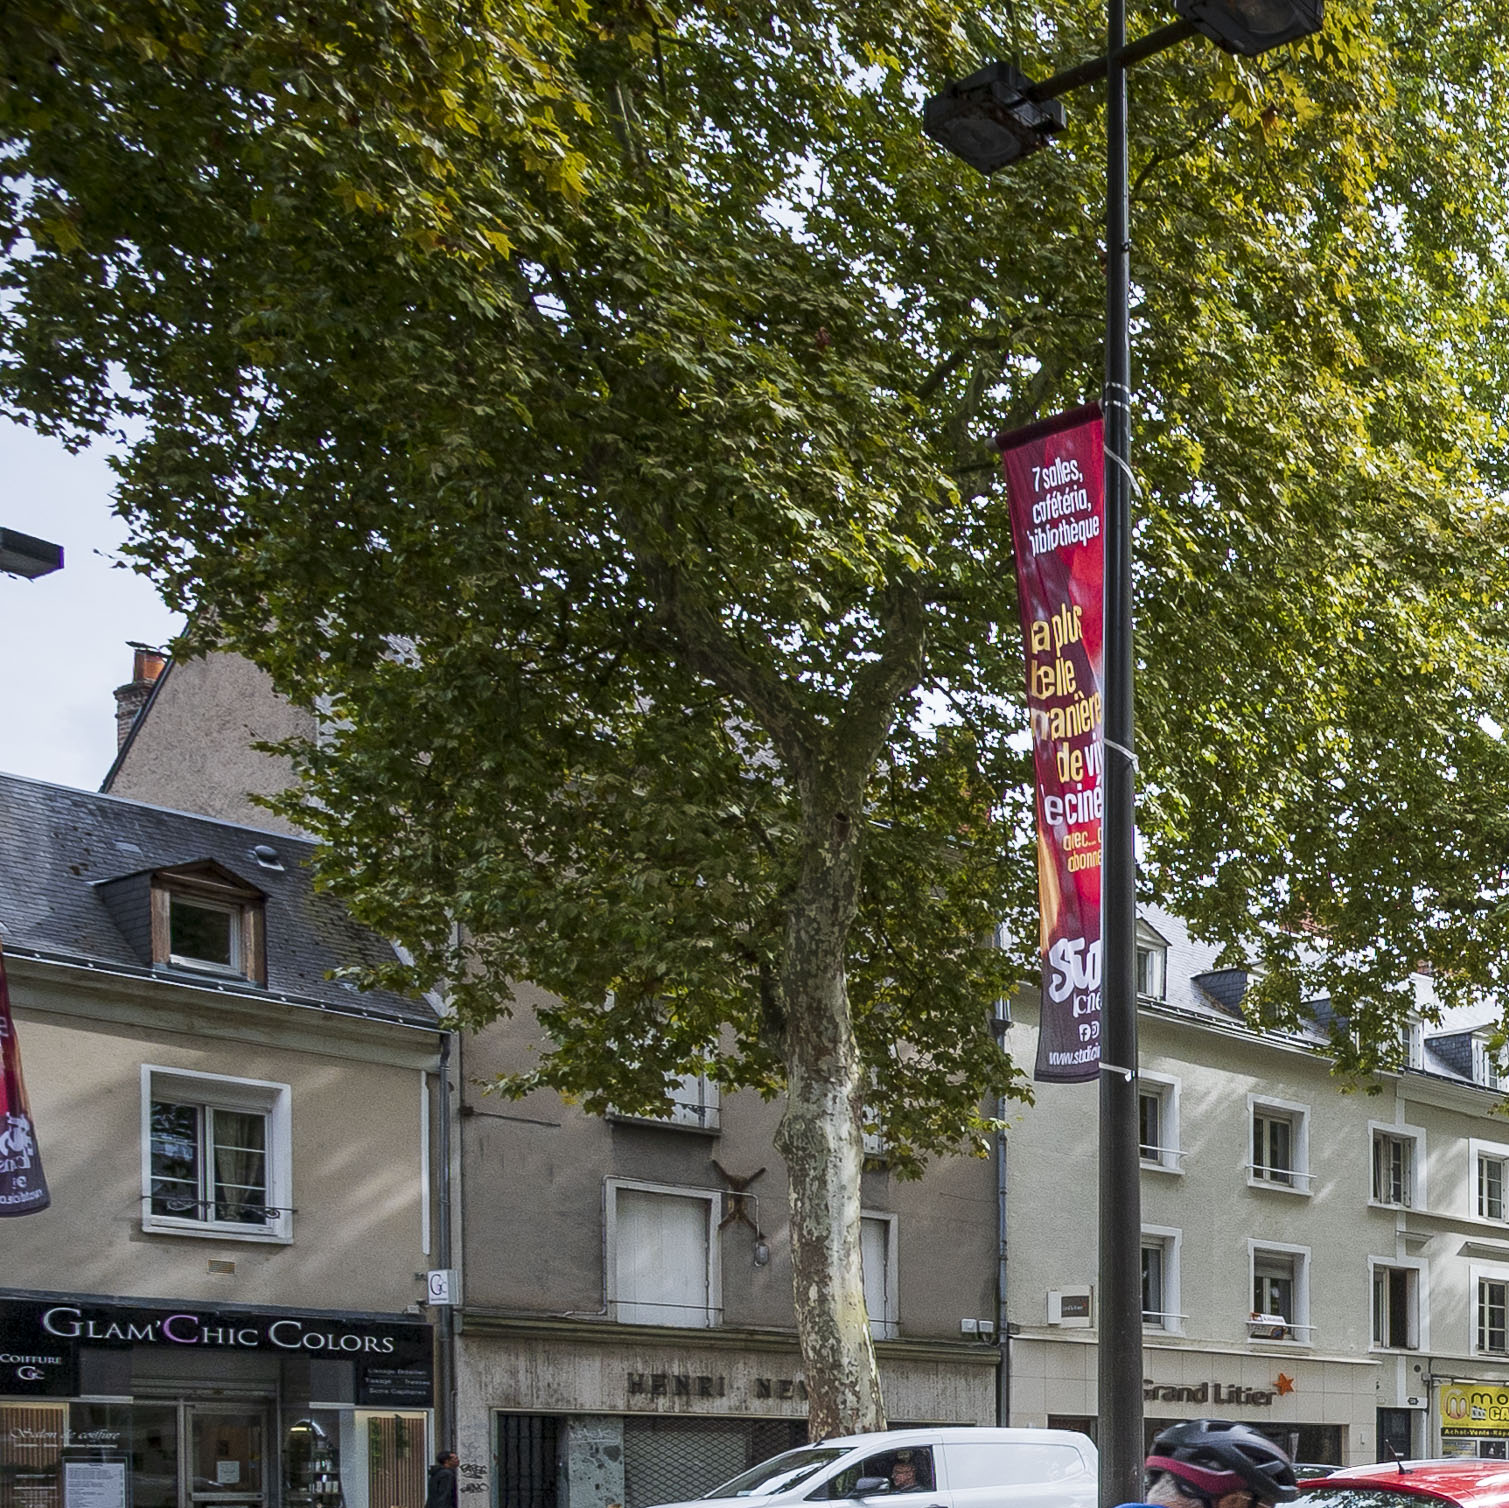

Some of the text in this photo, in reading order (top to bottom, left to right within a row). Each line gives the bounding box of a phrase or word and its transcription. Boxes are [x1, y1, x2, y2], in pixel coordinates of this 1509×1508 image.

[1032, 457, 1083, 492] 7 salles,
[1032, 484, 1092, 525] cafétéria,
[1056, 742, 1083, 783] de
[269, 1320, 394, 1354] COLORS
[627, 1373, 726, 1398] HENRI
[1213, 1382, 1277, 1406] Litier
[10, 1427, 57, 1441] Salon
